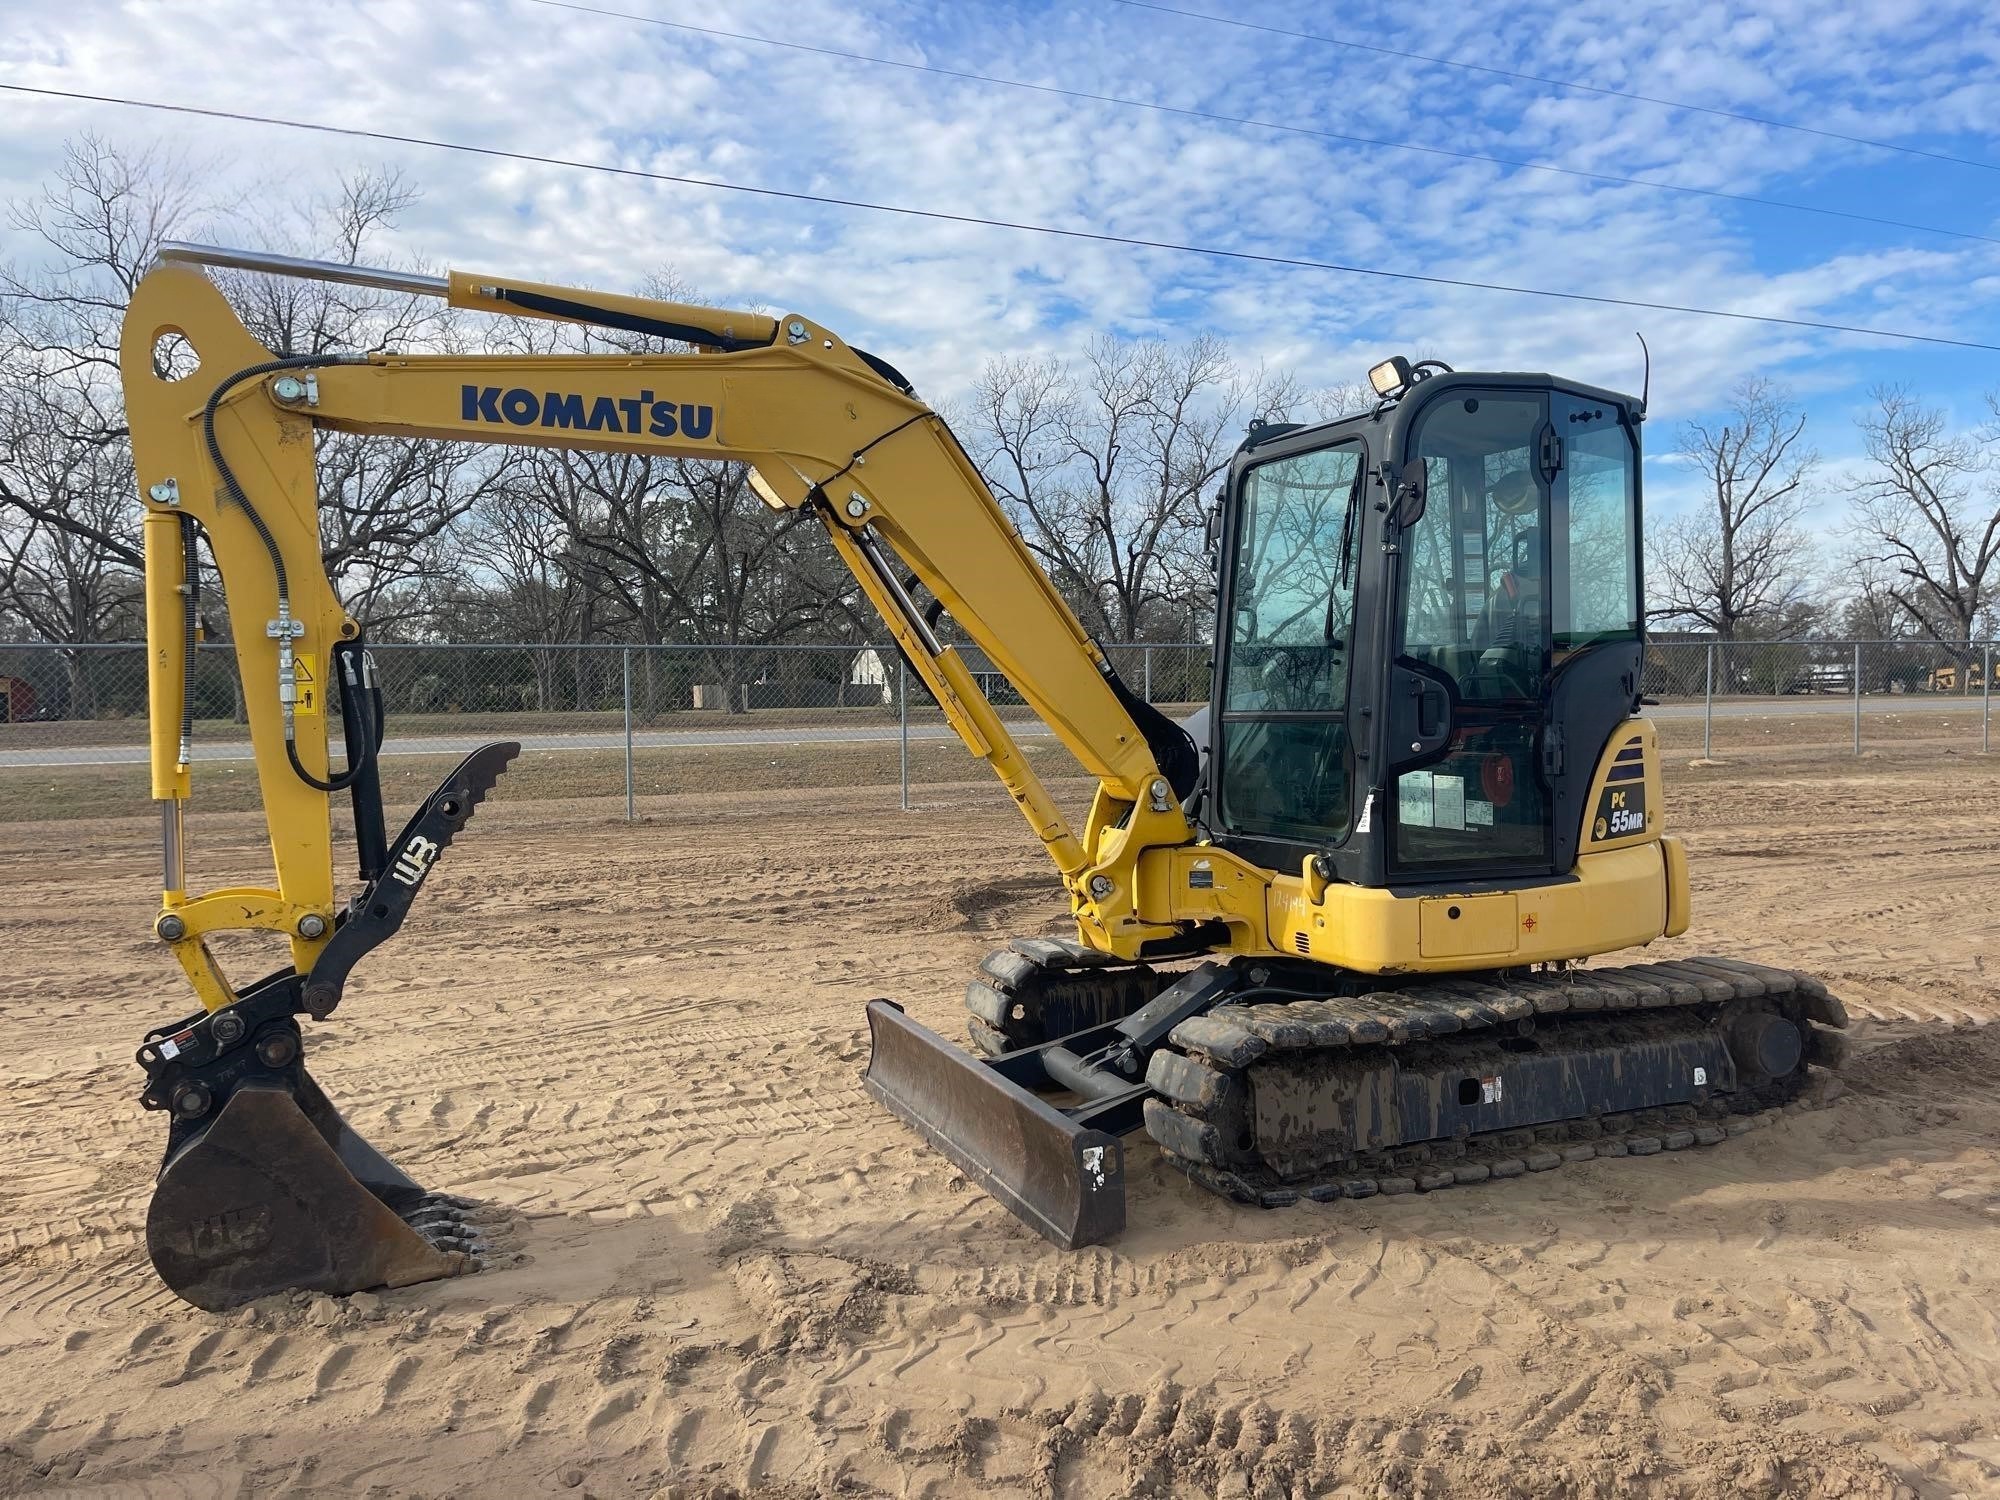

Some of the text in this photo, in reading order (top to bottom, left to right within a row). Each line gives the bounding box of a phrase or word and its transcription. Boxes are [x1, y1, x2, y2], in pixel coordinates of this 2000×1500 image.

[461, 384, 713, 440] KOMATSU
[1611, 791, 1626, 809] PC
[1610, 809, 1644, 834] 55MR
